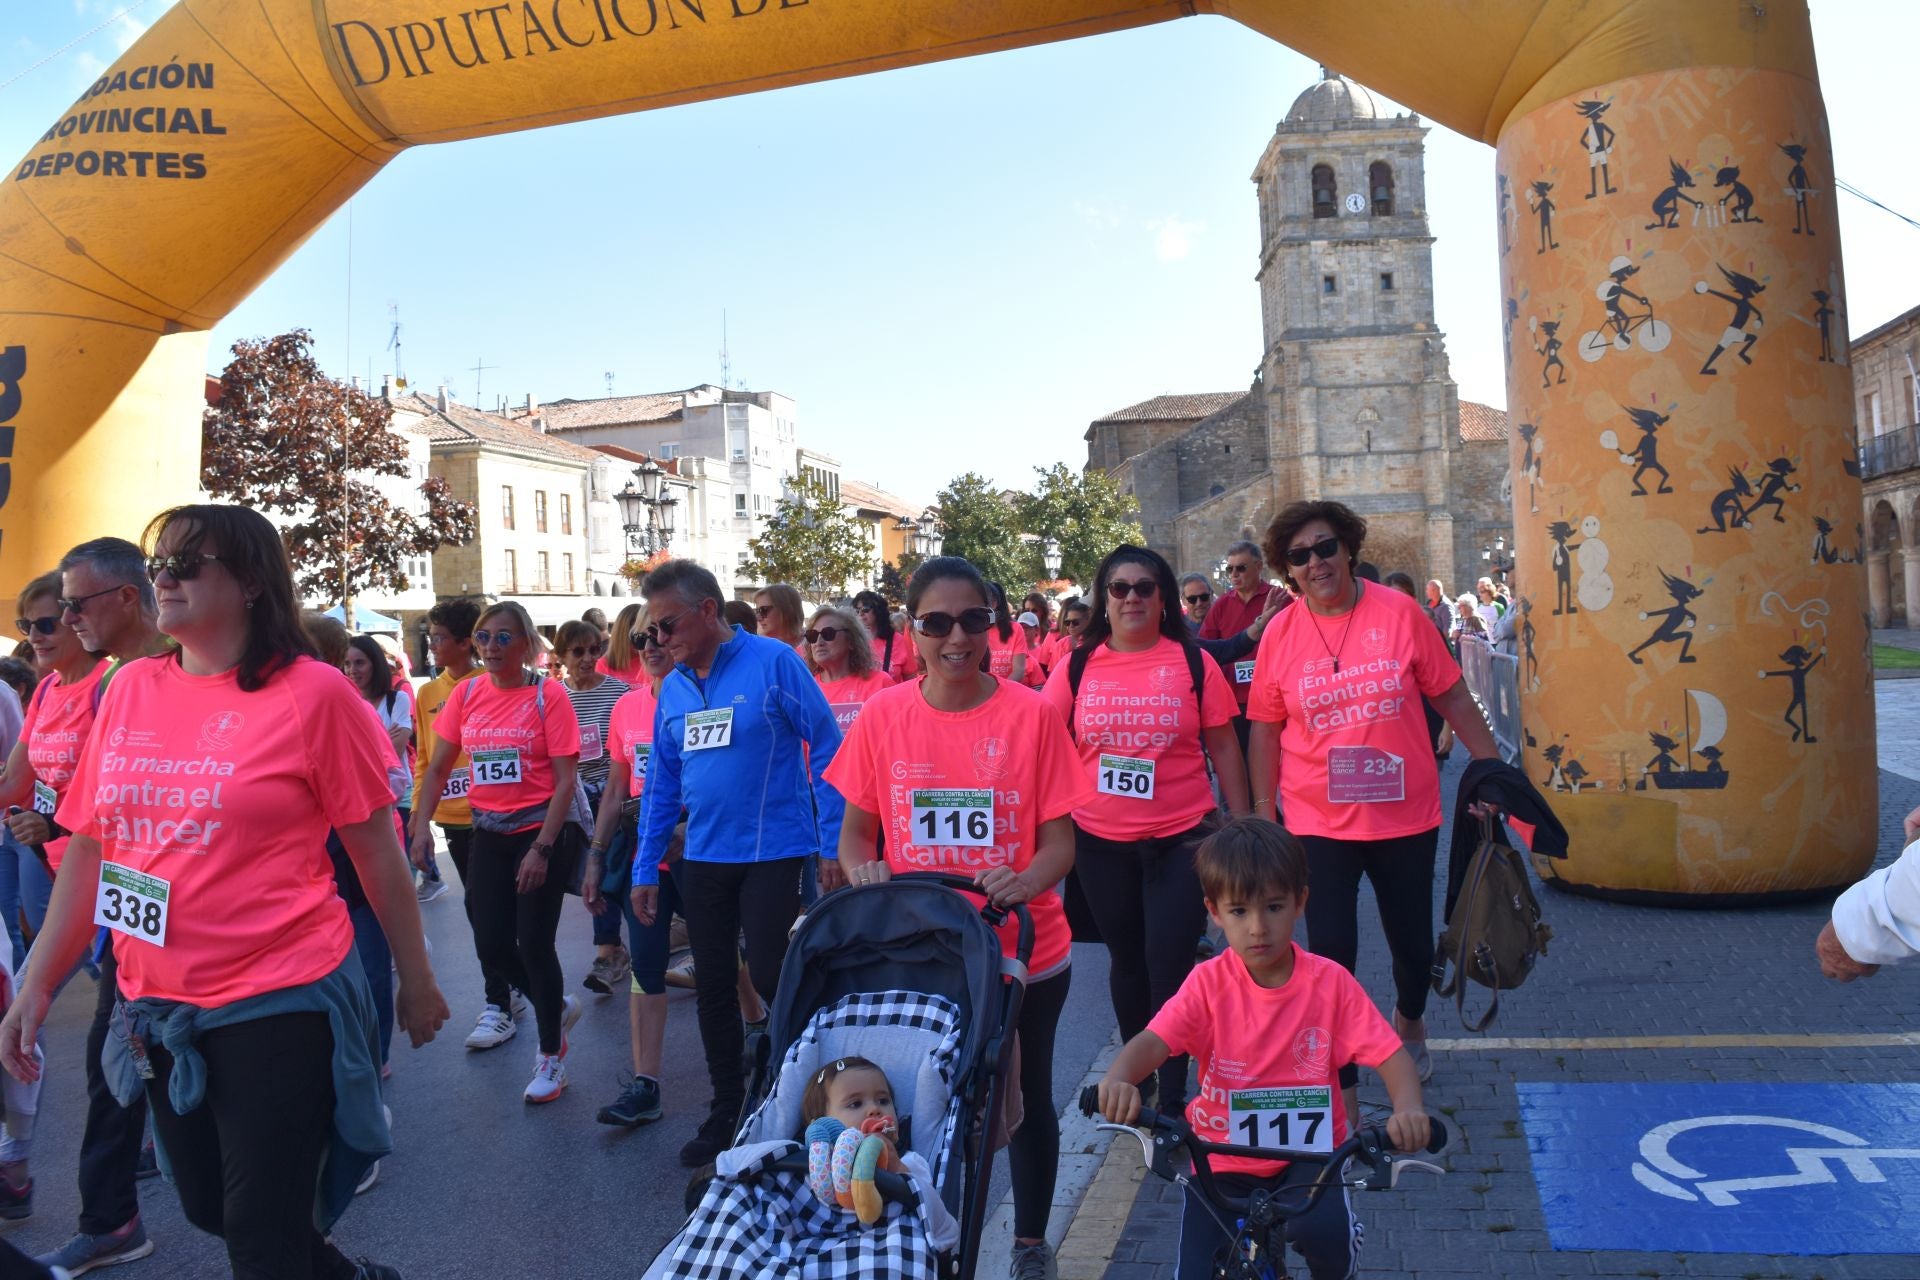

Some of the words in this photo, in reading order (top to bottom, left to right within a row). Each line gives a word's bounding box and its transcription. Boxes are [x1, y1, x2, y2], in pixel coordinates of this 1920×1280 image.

[15, 150, 207, 181] DEPORTES
[1304, 676, 1326, 689] En
[1331, 658, 1400, 683] marcha
[1086, 693, 1106, 707] En
[1111, 693, 1182, 708] marcha
[1306, 680, 1379, 709] contra
[1382, 673, 1403, 692] el
[1085, 709, 1155, 726] contra
[1158, 710, 1180, 727] el
[1313, 696, 1405, 730] cáncer
[480, 726, 535, 738] marcha
[687, 722, 729, 747] 377
[1087, 726, 1179, 748] cáncer
[102, 751, 127, 773] En
[130, 756, 235, 776] marcha
[477, 761, 518, 781] 154
[1363, 758, 1398, 776] 234
[95, 780, 185, 808] contra
[190, 782, 223, 809] el
[1103, 769, 1150, 794] 150
[98, 807, 222, 846] cáncer
[920, 811, 989, 840] 116
[103, 888, 162, 937] 338
[1201, 1074, 1226, 1104] En
[1269, 1090, 1293, 1098] CONTRA
[1239, 1112, 1325, 1147] 117
